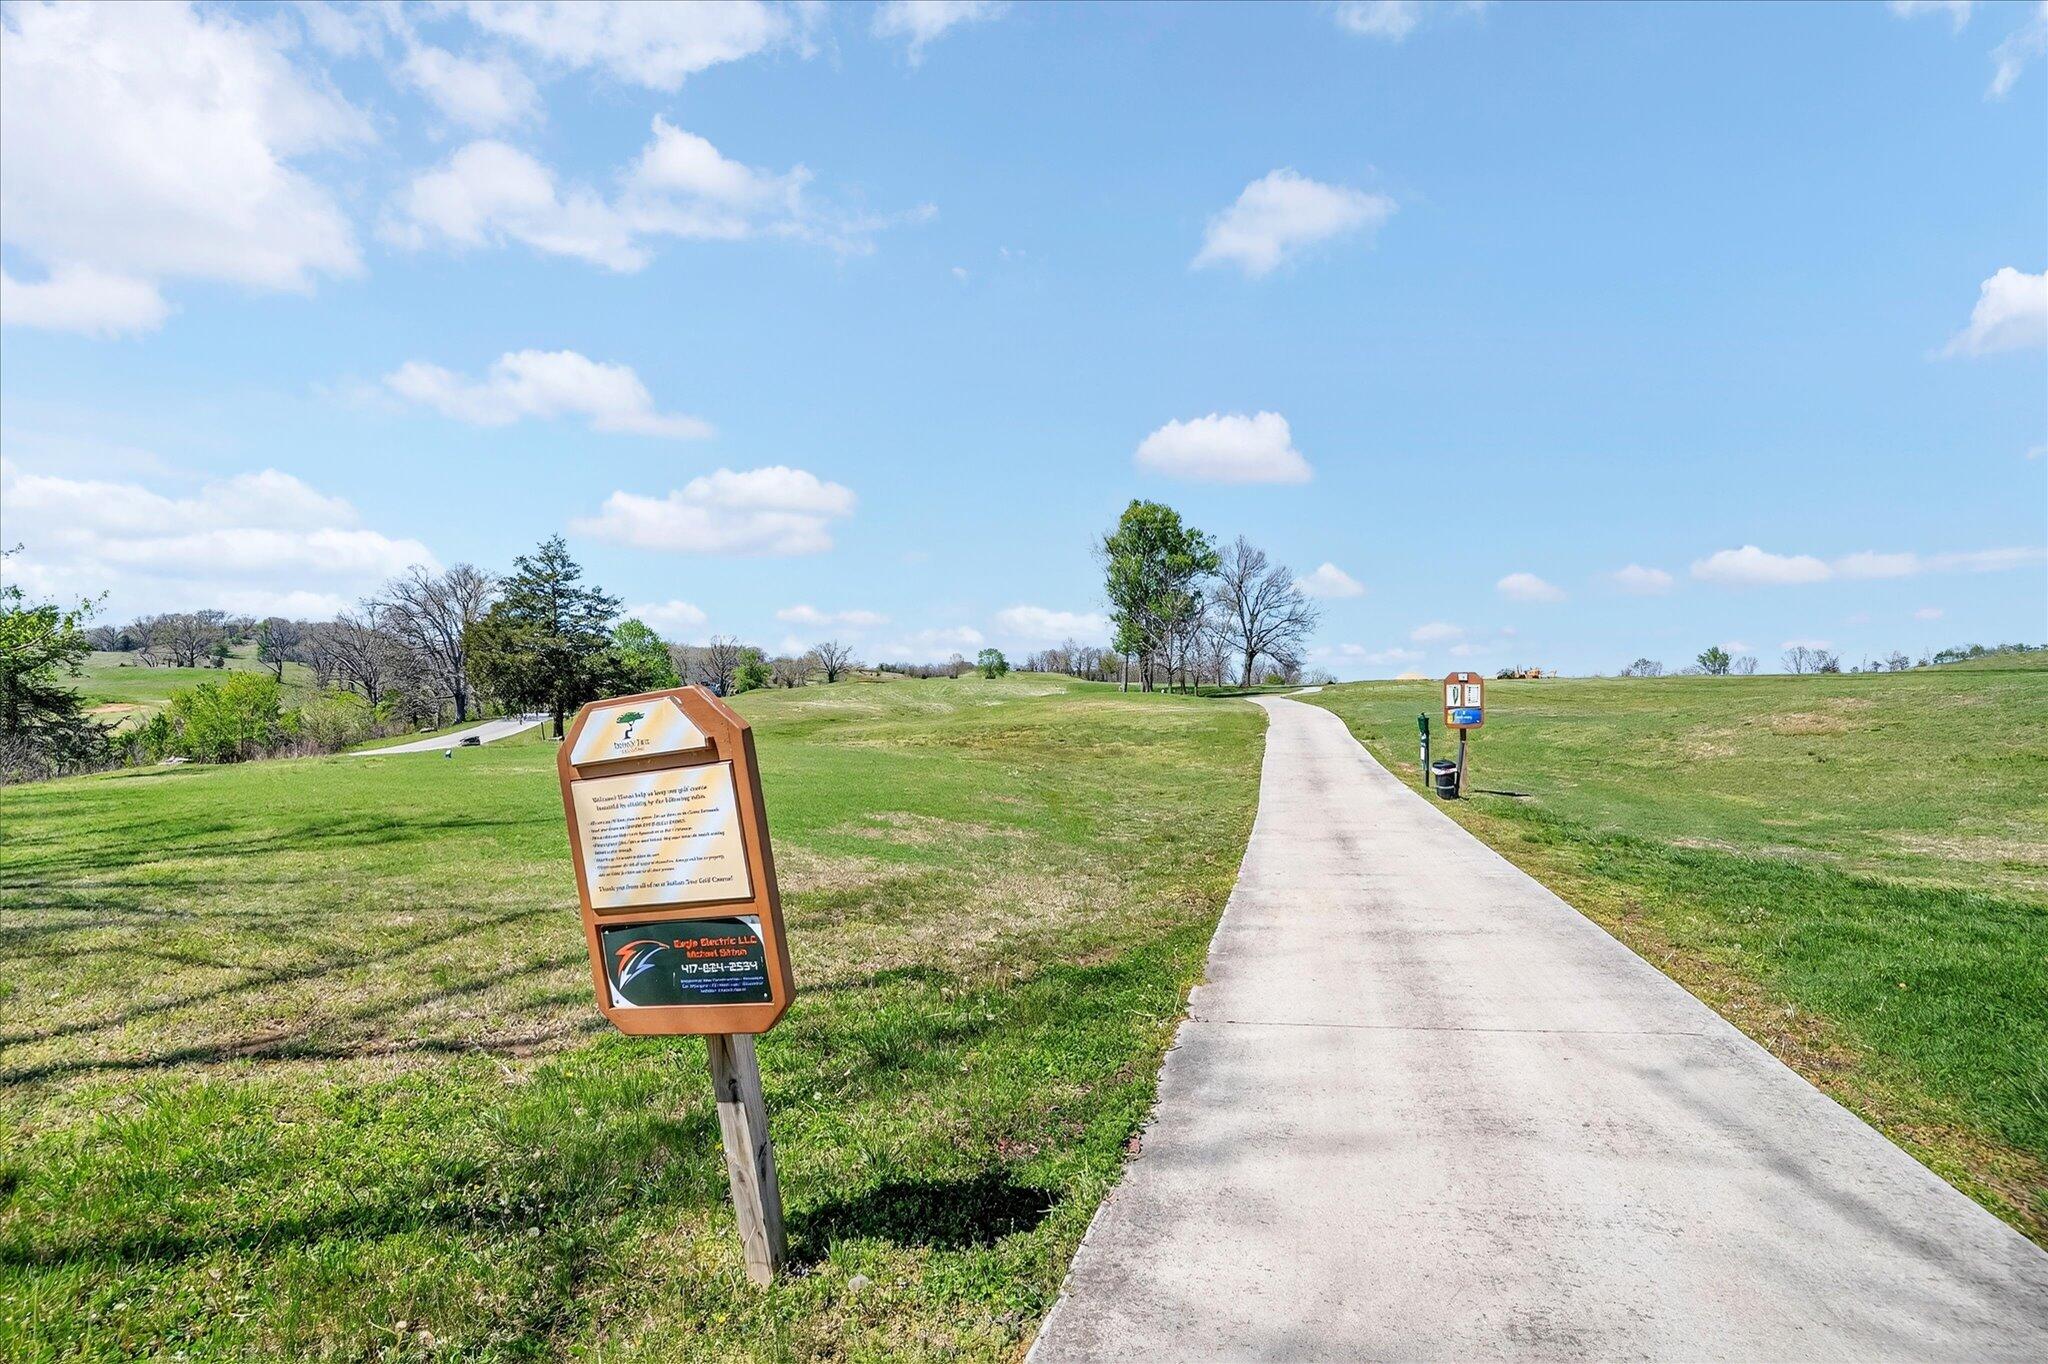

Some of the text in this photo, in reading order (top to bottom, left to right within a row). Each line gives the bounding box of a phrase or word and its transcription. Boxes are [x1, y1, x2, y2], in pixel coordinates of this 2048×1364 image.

[634, 791, 646, 800] help
[598, 885, 615, 893] Thank
[616, 884, 625, 892] you
[625, 882, 639, 890] from
[673, 935, 758, 950] Eagle Electric LLC
